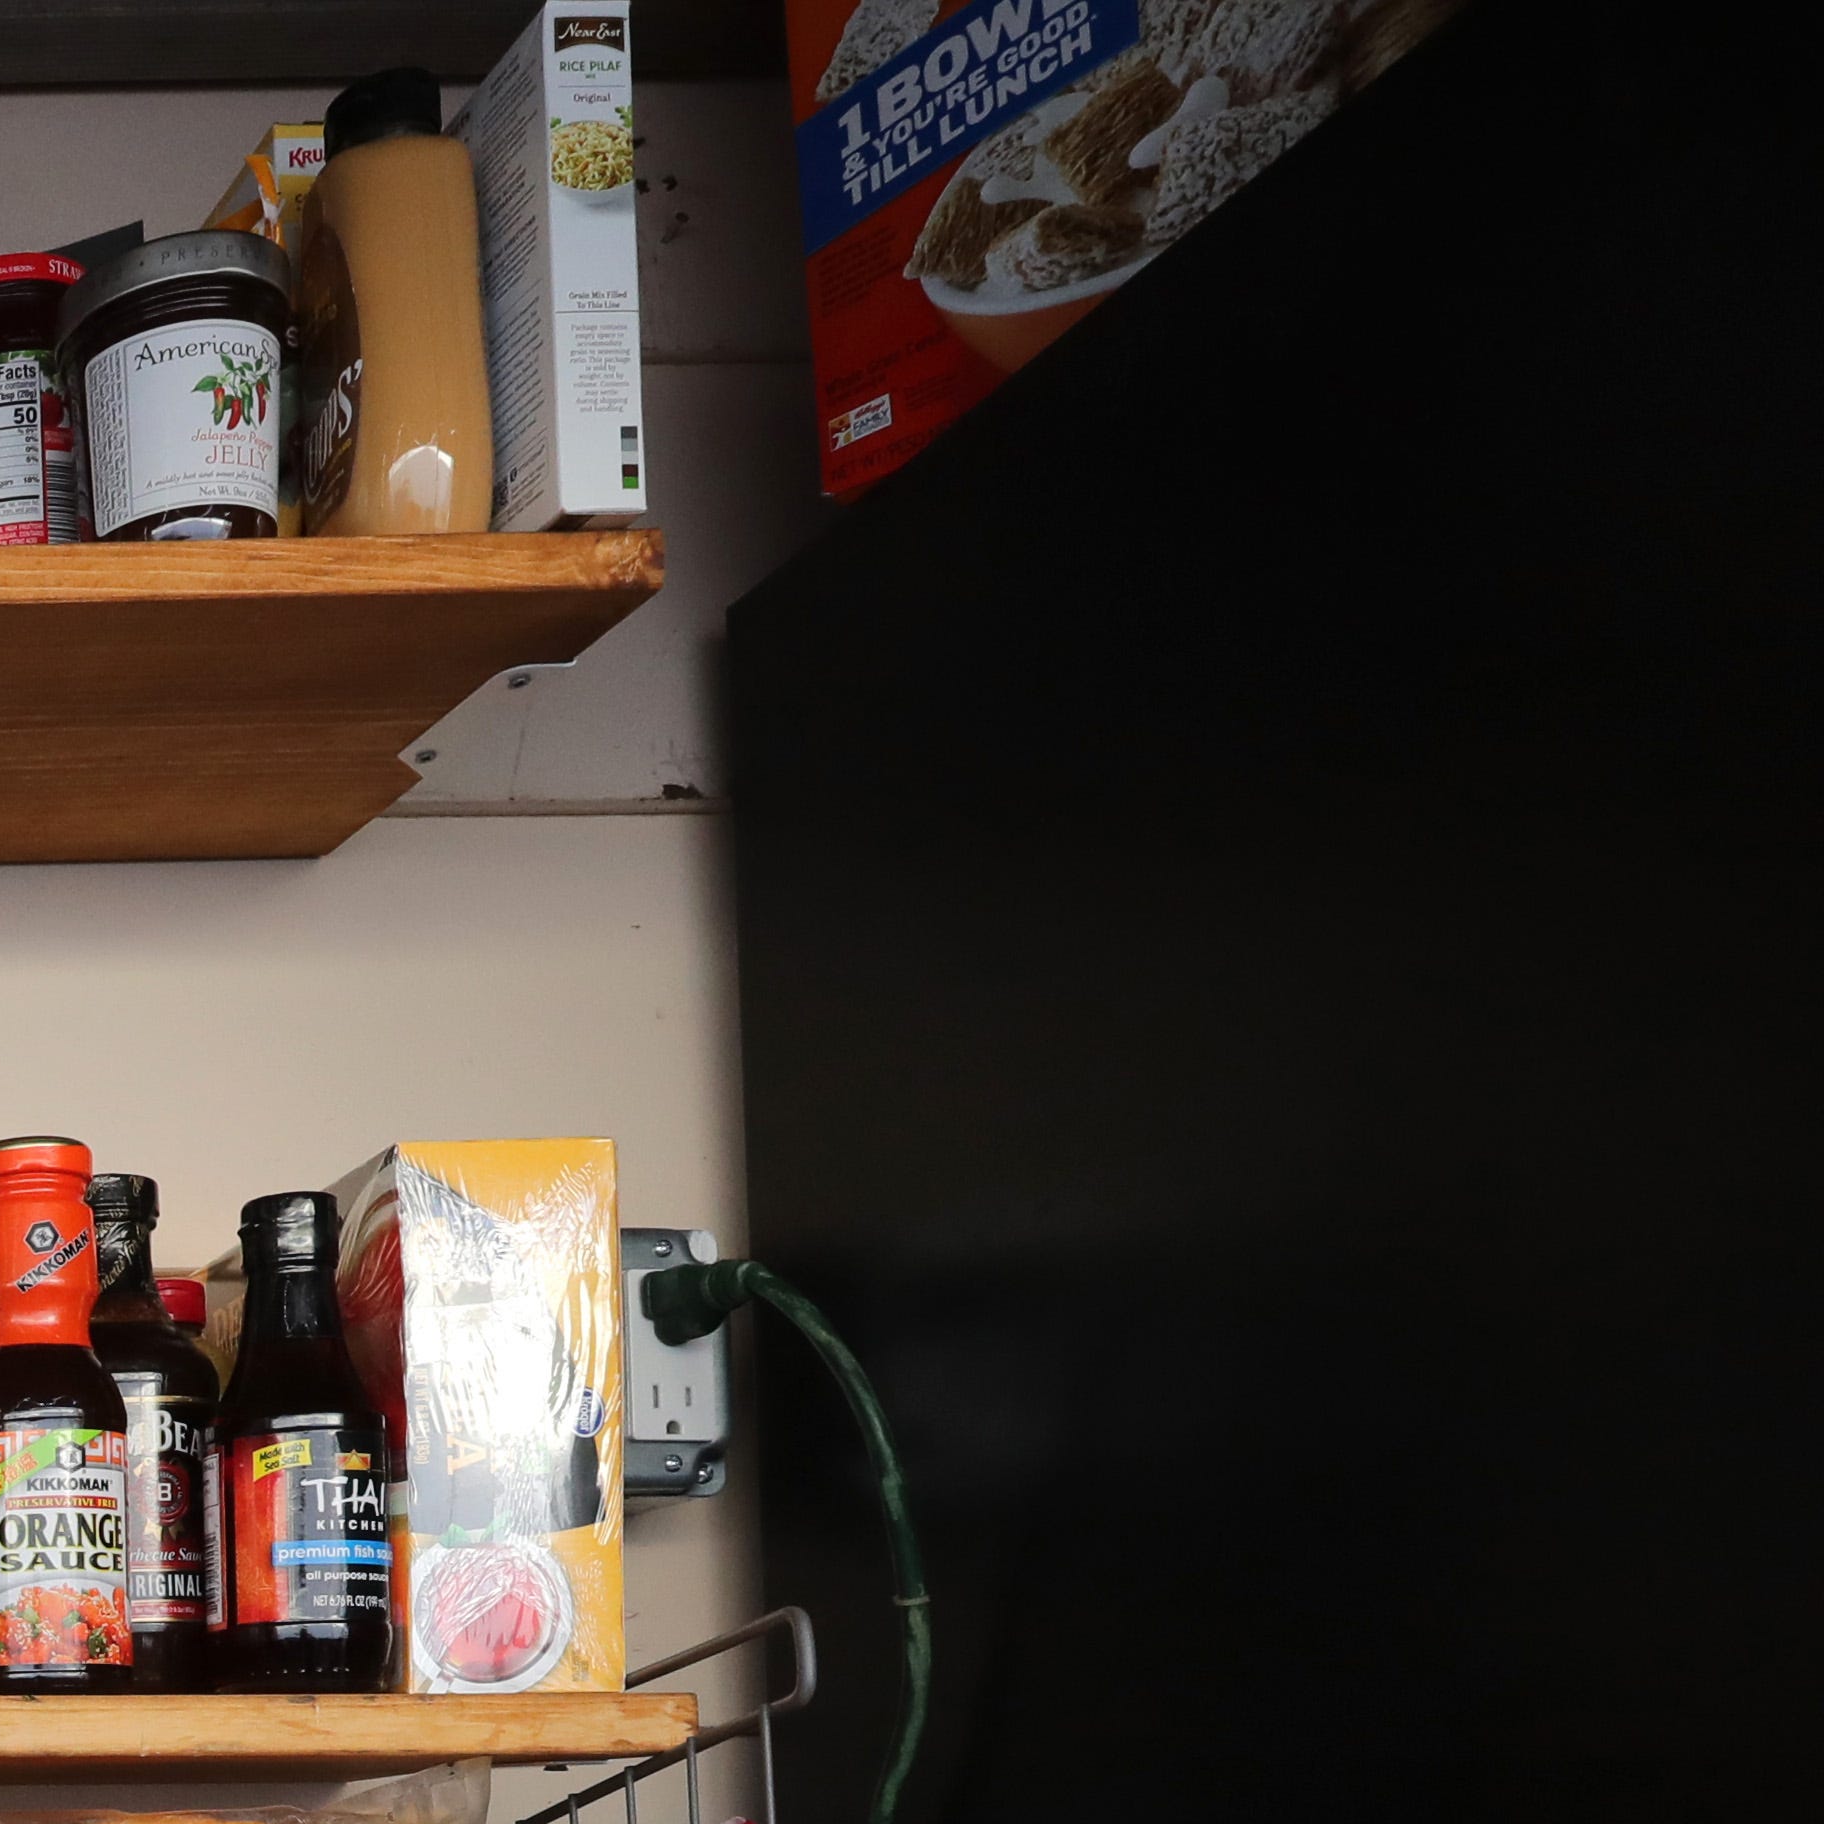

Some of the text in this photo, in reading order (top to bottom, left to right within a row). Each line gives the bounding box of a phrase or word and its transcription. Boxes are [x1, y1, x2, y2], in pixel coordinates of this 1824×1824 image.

[998, 2, 1089, 72] GOOD
[559, 61, 622, 72] RICE PILAF
[573, 92, 611, 105] Original
[843, 22, 1092, 205] TILL LUNCH
[205, 445, 268, 472] JELLY
[26, 1478, 109, 1492] KIKKOMAN
[316, 1519, 385, 1532] KITCHEN
[0, 1552, 123, 1572] SAUCE
[278, 1543, 350, 1562] premium
